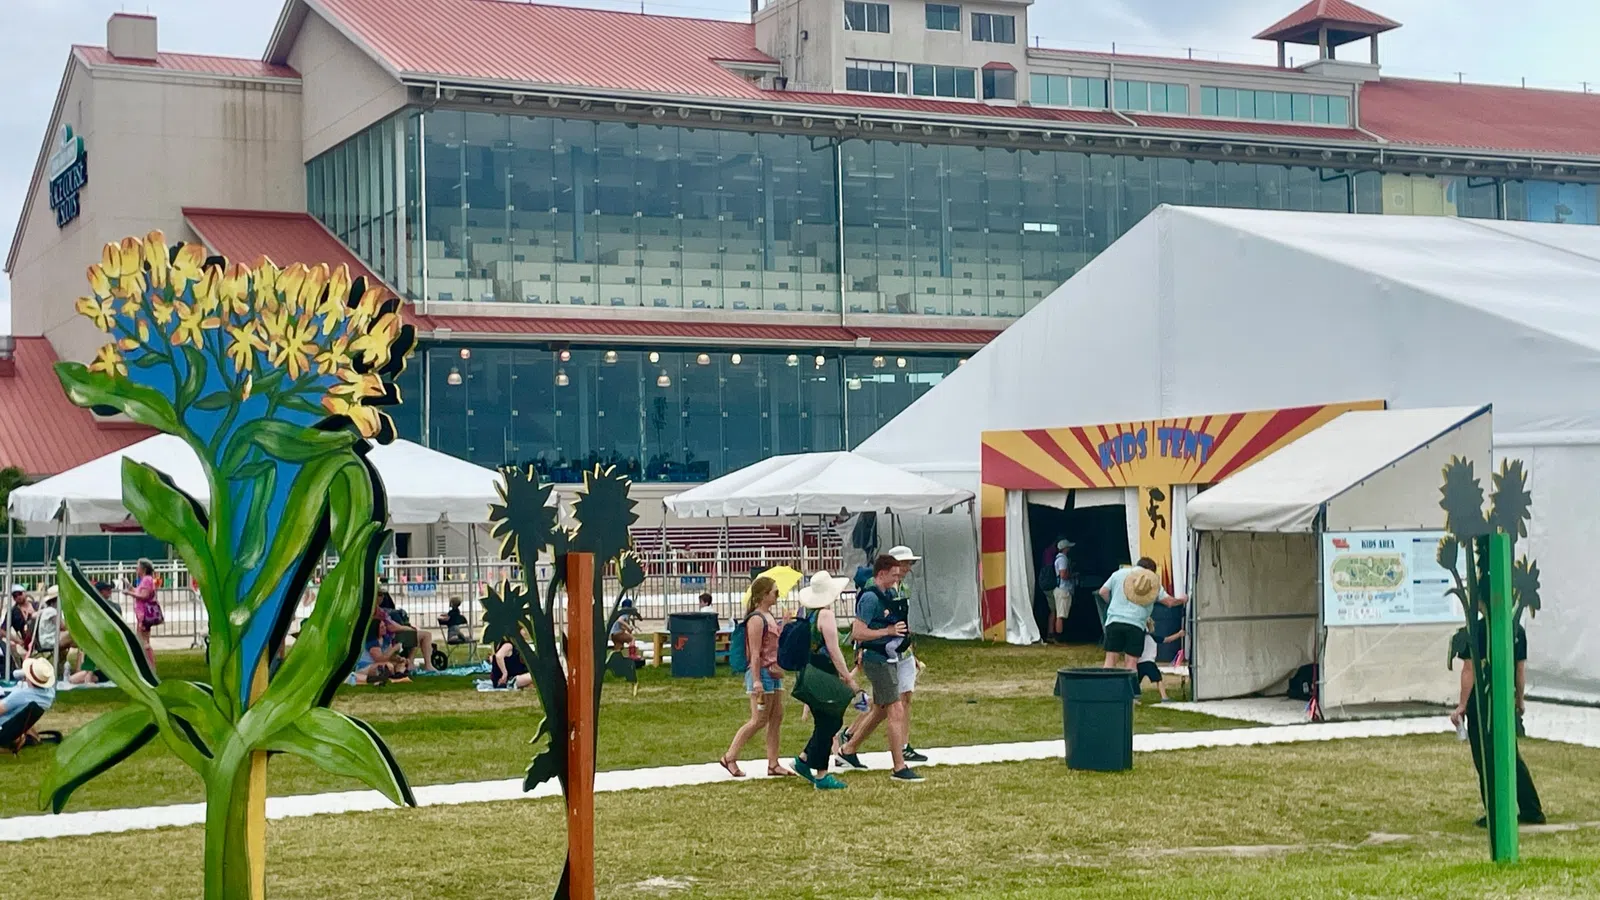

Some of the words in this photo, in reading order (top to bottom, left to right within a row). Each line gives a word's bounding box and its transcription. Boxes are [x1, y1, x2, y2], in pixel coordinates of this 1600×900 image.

[1098, 428, 1148, 473] KIDS
[1157, 426, 1215, 465] TENT
[1361, 539, 1377, 549] KIDS
[1378, 539, 1395, 549] AREA
